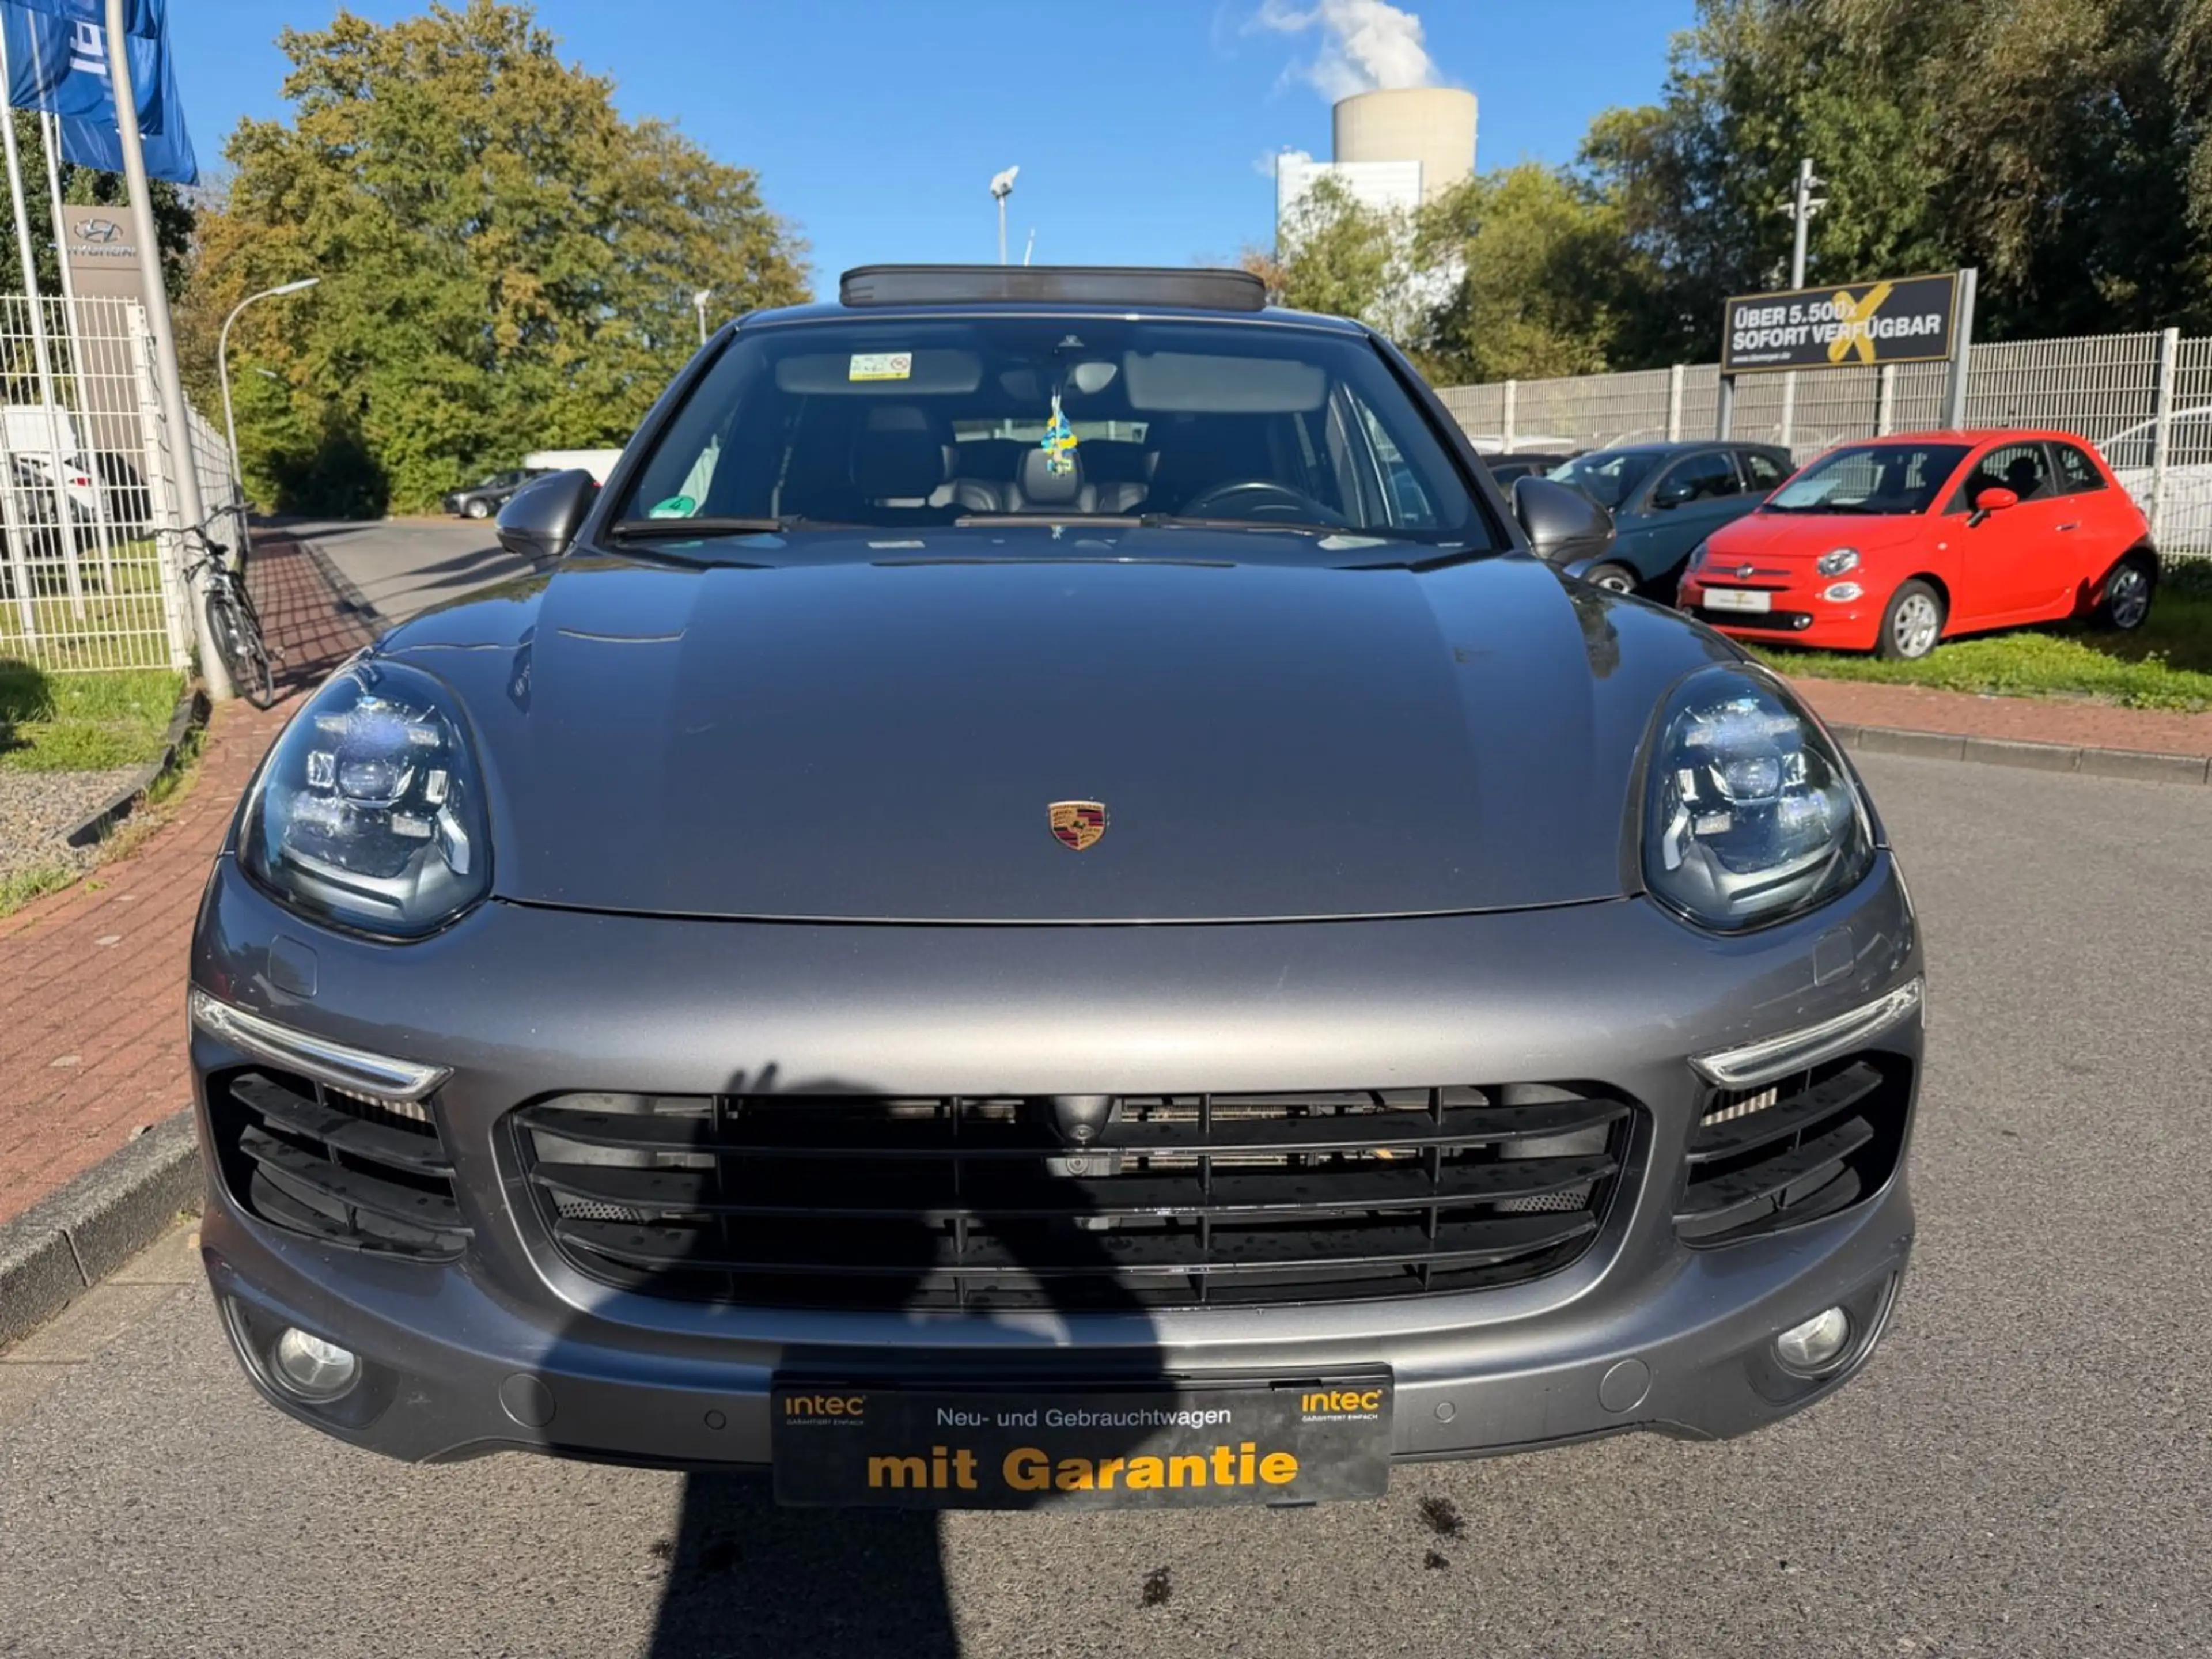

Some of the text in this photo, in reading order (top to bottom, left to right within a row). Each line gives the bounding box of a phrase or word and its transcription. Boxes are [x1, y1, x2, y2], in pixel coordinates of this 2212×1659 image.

[1734, 306, 1787, 330] ÜBER
[1733, 314, 1941, 351] SOFORT VERFÜGBAR
[785, 1395, 864, 1415] intec
[1302, 1390, 1380, 1412] intec
[937, 1408, 1232, 1429] Neu- und Gebrauchtwagen
[868, 1441, 1300, 1491] mit Garantie
